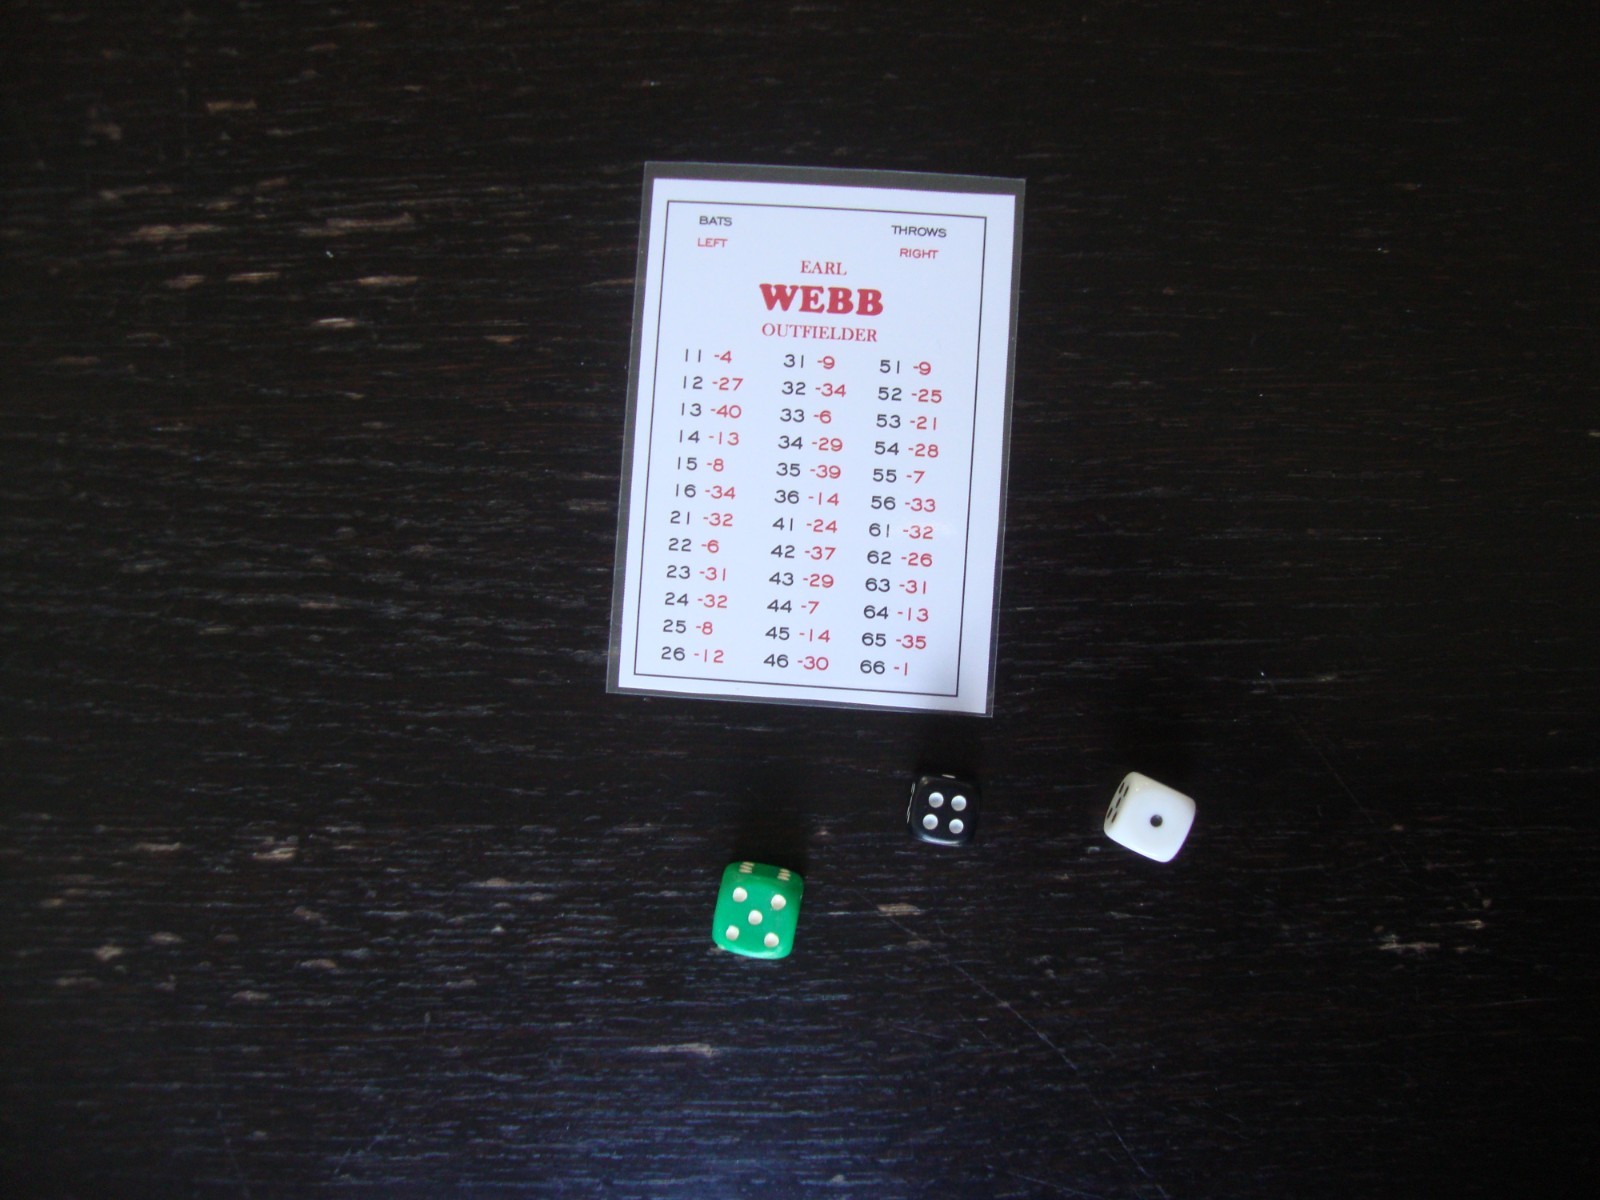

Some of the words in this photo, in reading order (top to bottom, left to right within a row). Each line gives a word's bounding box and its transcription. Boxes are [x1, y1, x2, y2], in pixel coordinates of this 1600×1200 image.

[698, 215, 733, 227] BATS
[890, 224, 948, 239] THROWS
[697, 237, 728, 248] LEFT
[899, 247, 939, 260] RIGHT
[800, 260, 847, 276] EARL
[758, 282, 884, 317] WEBB
[761, 322, 878, 343] OUTFIELDER
[684, 348, 702, 363] 11
[713, 350, 733, 364] -4
[783, 353, 805, 369] 31
[816, 355, 836, 371] -9
[879, 359, 901, 375] 51
[912, 360, 932, 376] -9
[682, 375, 704, 390] 12
[711, 376, 744, 392] -27
[781, 380, 807, 396] 32
[815, 382, 847, 398] -34
[877, 386, 903, 402] 52
[911, 388, 943, 405] -25
[680, 402, 702, 418] 13
[710, 404, 742, 420] -40
[779, 407, 805, 424] 33
[813, 409, 832, 425] -6
[875, 413, 902, 430] 53
[909, 415, 937, 431] -21
[679, 429, 701, 444] 14
[708, 431, 740, 447] -13
[777, 434, 804, 451] 34
[811, 436, 844, 453] -29
[873, 440, 900, 456] 54
[907, 442, 939, 459] -28
[677, 456, 698, 472] 15
[706, 457, 725, 473] -8
[775, 461, 801, 478] 35
[809, 464, 842, 480] -39
[872, 467, 898, 484] 55
[906, 469, 926, 484] -7
[675, 483, 697, 499] 16
[704, 484, 737, 500] -34
[773, 489, 800, 505] 36
[808, 491, 840, 507] -14
[870, 495, 897, 511] 56
[904, 497, 936, 513] -33
[669, 509, 691, 526] 21
[703, 512, 734, 527] -32
[771, 516, 794, 532] 41
[806, 518, 838, 534] -24
[868, 522, 890, 539] 61
[902, 524, 934, 540] -32
[668, 537, 692, 553] 22
[700, 539, 720, 554] -6
[770, 544, 796, 560] 42
[804, 545, 837, 561] -37
[866, 549, 892, 566] 62
[900, 551, 933, 568] -26
[666, 564, 691, 580] 23
[699, 566, 727, 582] -31
[768, 571, 795, 587] 43
[802, 572, 835, 589] -29
[864, 577, 891, 593] 63
[899, 579, 927, 595] -31
[664, 591, 690, 607] 24
[697, 593, 728, 609] -32
[766, 598, 793, 614] 44
[800, 600, 820, 615] -7
[863, 604, 890, 620] 64
[897, 607, 929, 623] -13
[662, 618, 687, 635] 25
[695, 621, 714, 636] -8
[764, 625, 791, 642] 45
[799, 628, 831, 644] -14
[861, 631, 887, 648] 65
[895, 634, 927, 650] -35
[660, 645, 686, 662] 26
[693, 648, 725, 664] -12
[762, 653, 790, 669] 46
[797, 655, 830, 672] -30
[859, 659, 886, 676] 66
[893, 661, 909, 677] -1
